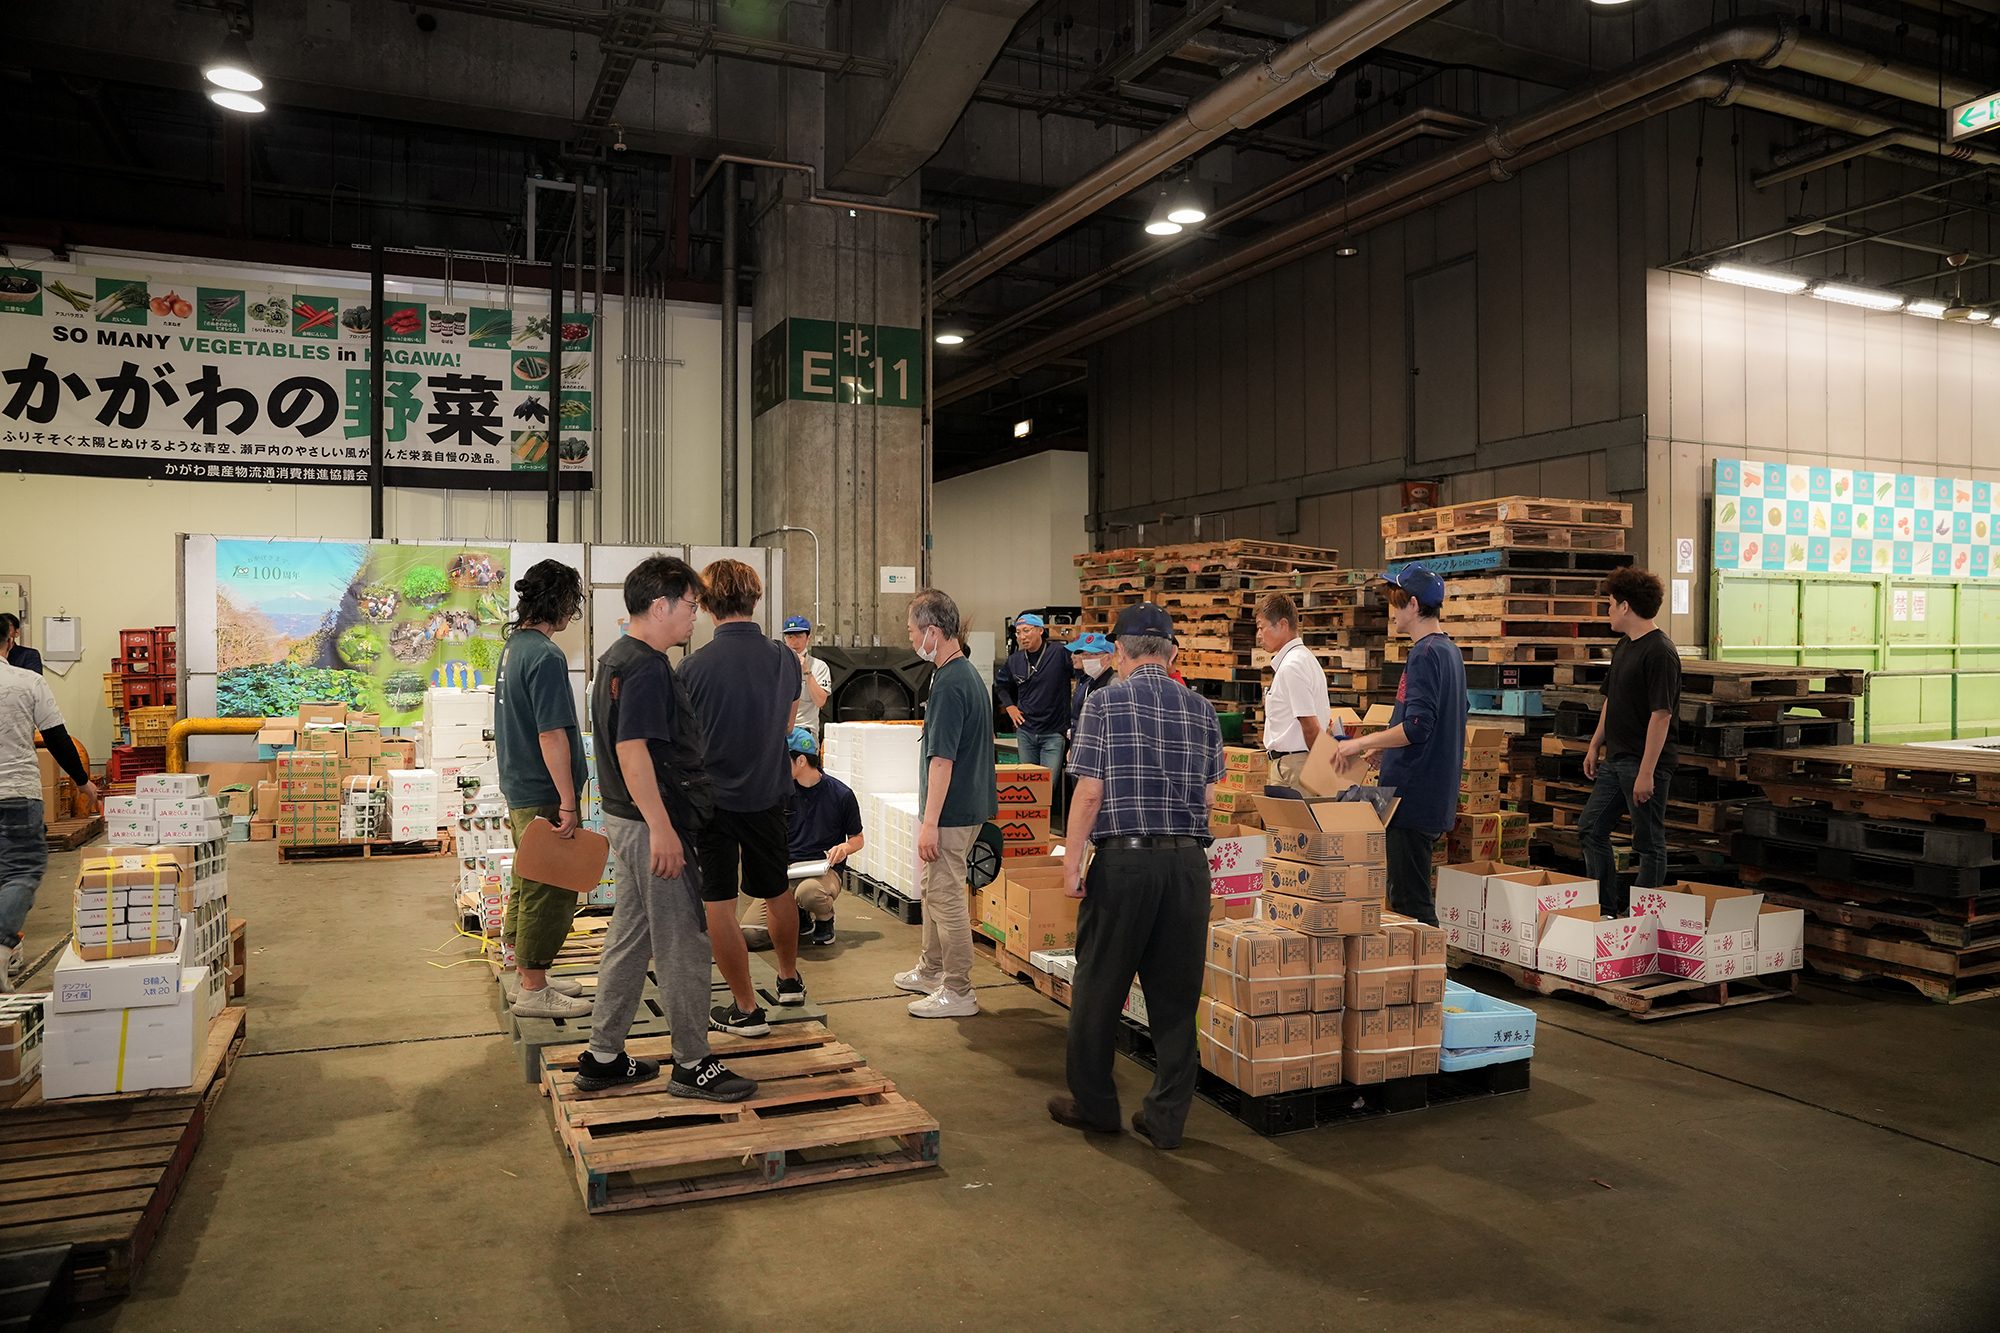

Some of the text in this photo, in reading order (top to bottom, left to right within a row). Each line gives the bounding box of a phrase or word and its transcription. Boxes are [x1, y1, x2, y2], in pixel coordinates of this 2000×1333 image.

[53, 326, 88, 343] SO
[97, 330, 171, 349] MANY
[179, 336, 330, 360] VEGETABLES
[338, 346, 356, 361] in
[843, 329, 869, 357] 北
[2, 353, 504, 446] かがわの野菜
[3, 431, 500, 464] ふりそそぐ太陽とぬけるような青空、瀬戸内のやさしい風がんだ栄養自慢の逸品。
[165, 463, 369, 482] かがわ農産物流通消費推進協議会
[1450, 907, 1460, 922] 彩
[1501, 918, 1513, 934] 彩
[1500, 941, 1511, 957] 彩
[1677, 935, 1689, 951] 彩
[1723, 935, 1733, 951] 彩
[1556, 956, 1567, 972] 彩
[1724, 959, 1735, 976] 彩
[1774, 952, 1784, 968] 彩
[143, 976, 169, 985] 8輪入
[158, 986, 170, 995] 20
